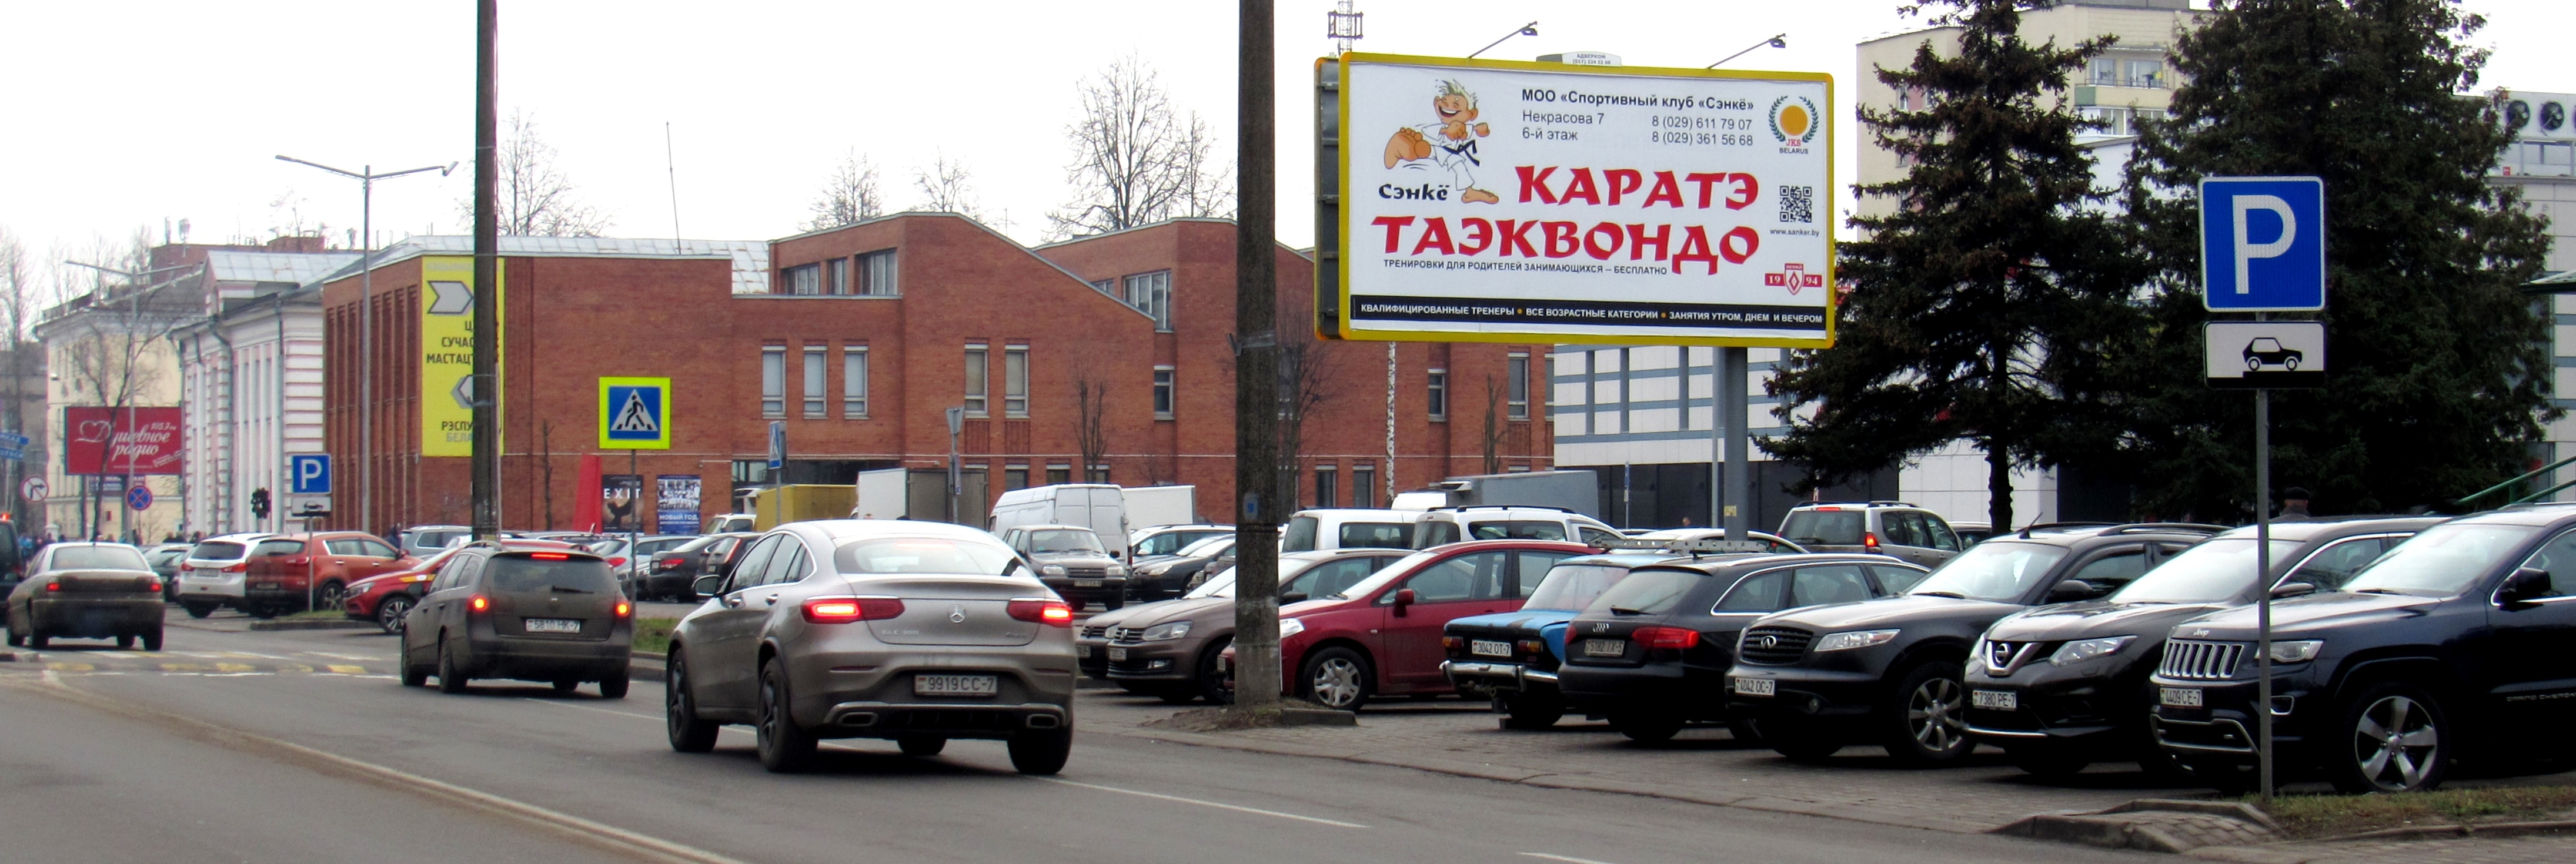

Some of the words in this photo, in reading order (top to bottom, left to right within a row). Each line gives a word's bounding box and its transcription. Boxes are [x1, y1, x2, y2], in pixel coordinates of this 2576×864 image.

[1522, 89, 1556, 102] МОО
[1561, 91, 1657, 106] «Спортивный
[1662, 96, 1693, 110] клуб
[1698, 97, 1754, 110] «Сэнкё»
[1523, 110, 1593, 125] Некрасова
[1597, 113, 1605, 125] 7
[1652, 116, 1659, 126] 8
[1663, 116, 1693, 130] (029)
[1696, 118, 1716, 129] 611
[1720, 119, 1735, 130] 79
[1738, 119, 1752, 130] 07
[1522, 127, 1543, 139] 6-й
[1547, 130, 1578, 140] этаж
[1652, 131, 1659, 142] 8
[1663, 132, 1693, 146] (029)
[1696, 133, 1716, 145] 361
[1722, 134, 1735, 145] 56
[1739, 135, 1753, 146] 68
[1514, 165, 1759, 210] КАРАТЭ
[1770, 229, 1820, 237] www.sanker.by
[1371, 216, 1759, 276] ТАЭКВОНДО
[2232, 195, 2297, 294] P
[1384, 259, 1444, 269] ТРЕНИРОВКИ
[1446, 261, 1465, 270] ДЛЯ
[1468, 262, 1522, 271] РОДИТЕЛЕЙ
[1524, 263, 1603, 273] ЗАНИМАЮЩИХСЯ
[1614, 266, 1668, 274] БЕСПЛАТНО
[1769, 275, 1780, 284] 19
[1806, 276, 1818, 285] 94
[1361, 304, 1469, 315] КВАЛИФИЦИРОВАННЫЕ
[1472, 306, 1515, 316] ТРЕНЕРЫ
[1526, 308, 1543, 316] ВСЕ
[1546, 309, 1606, 317] ВОЗРАСТНЫЕ
[1608, 310, 1658, 319] КАТЕГОРИИ
[1669, 312, 1709, 320] ЗАНЯТИЯ
[1712, 313, 1743, 322] УТРОМ,
[1745, 313, 1769, 322] ДНЕМ
[1782, 314, 1822, 323] ВЕЧЕРОМ
[442, 337, 474, 347] СУЧАС
[427, 354, 474, 365] МАСТАЦ
[442, 421, 473, 431] РЭСПУ
[301, 459, 322, 490] P
[604, 488, 641, 499] EXIT
